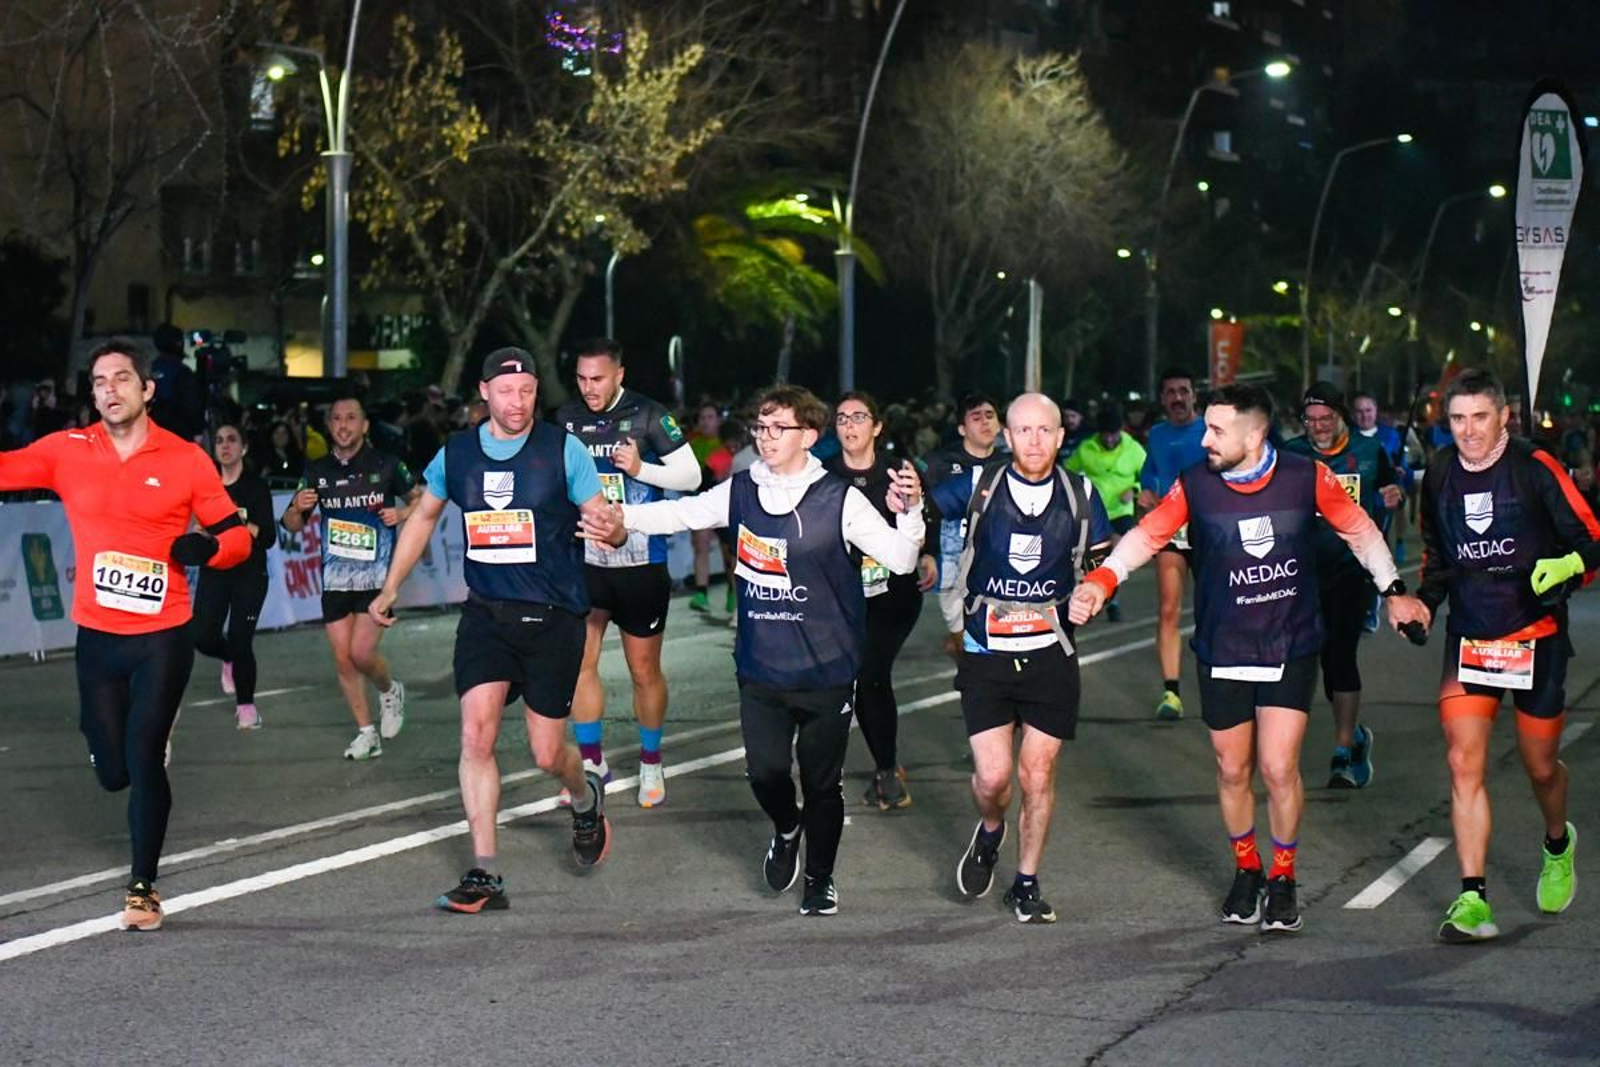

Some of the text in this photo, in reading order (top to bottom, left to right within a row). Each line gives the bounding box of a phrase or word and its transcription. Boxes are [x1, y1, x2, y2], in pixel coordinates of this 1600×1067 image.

[344, 491, 384, 508] ANTÓN
[331, 530, 371, 546] 2261
[1457, 537, 1515, 559] MEDAC
[97, 566, 164, 594] 10140
[1229, 559, 1298, 587] MEDAC
[745, 582, 808, 602] MEDAC
[986, 576, 1057, 597] MEDAC
[1471, 647, 1522, 659] AUXILIAR
[1485, 659, 1507, 669] RCP
